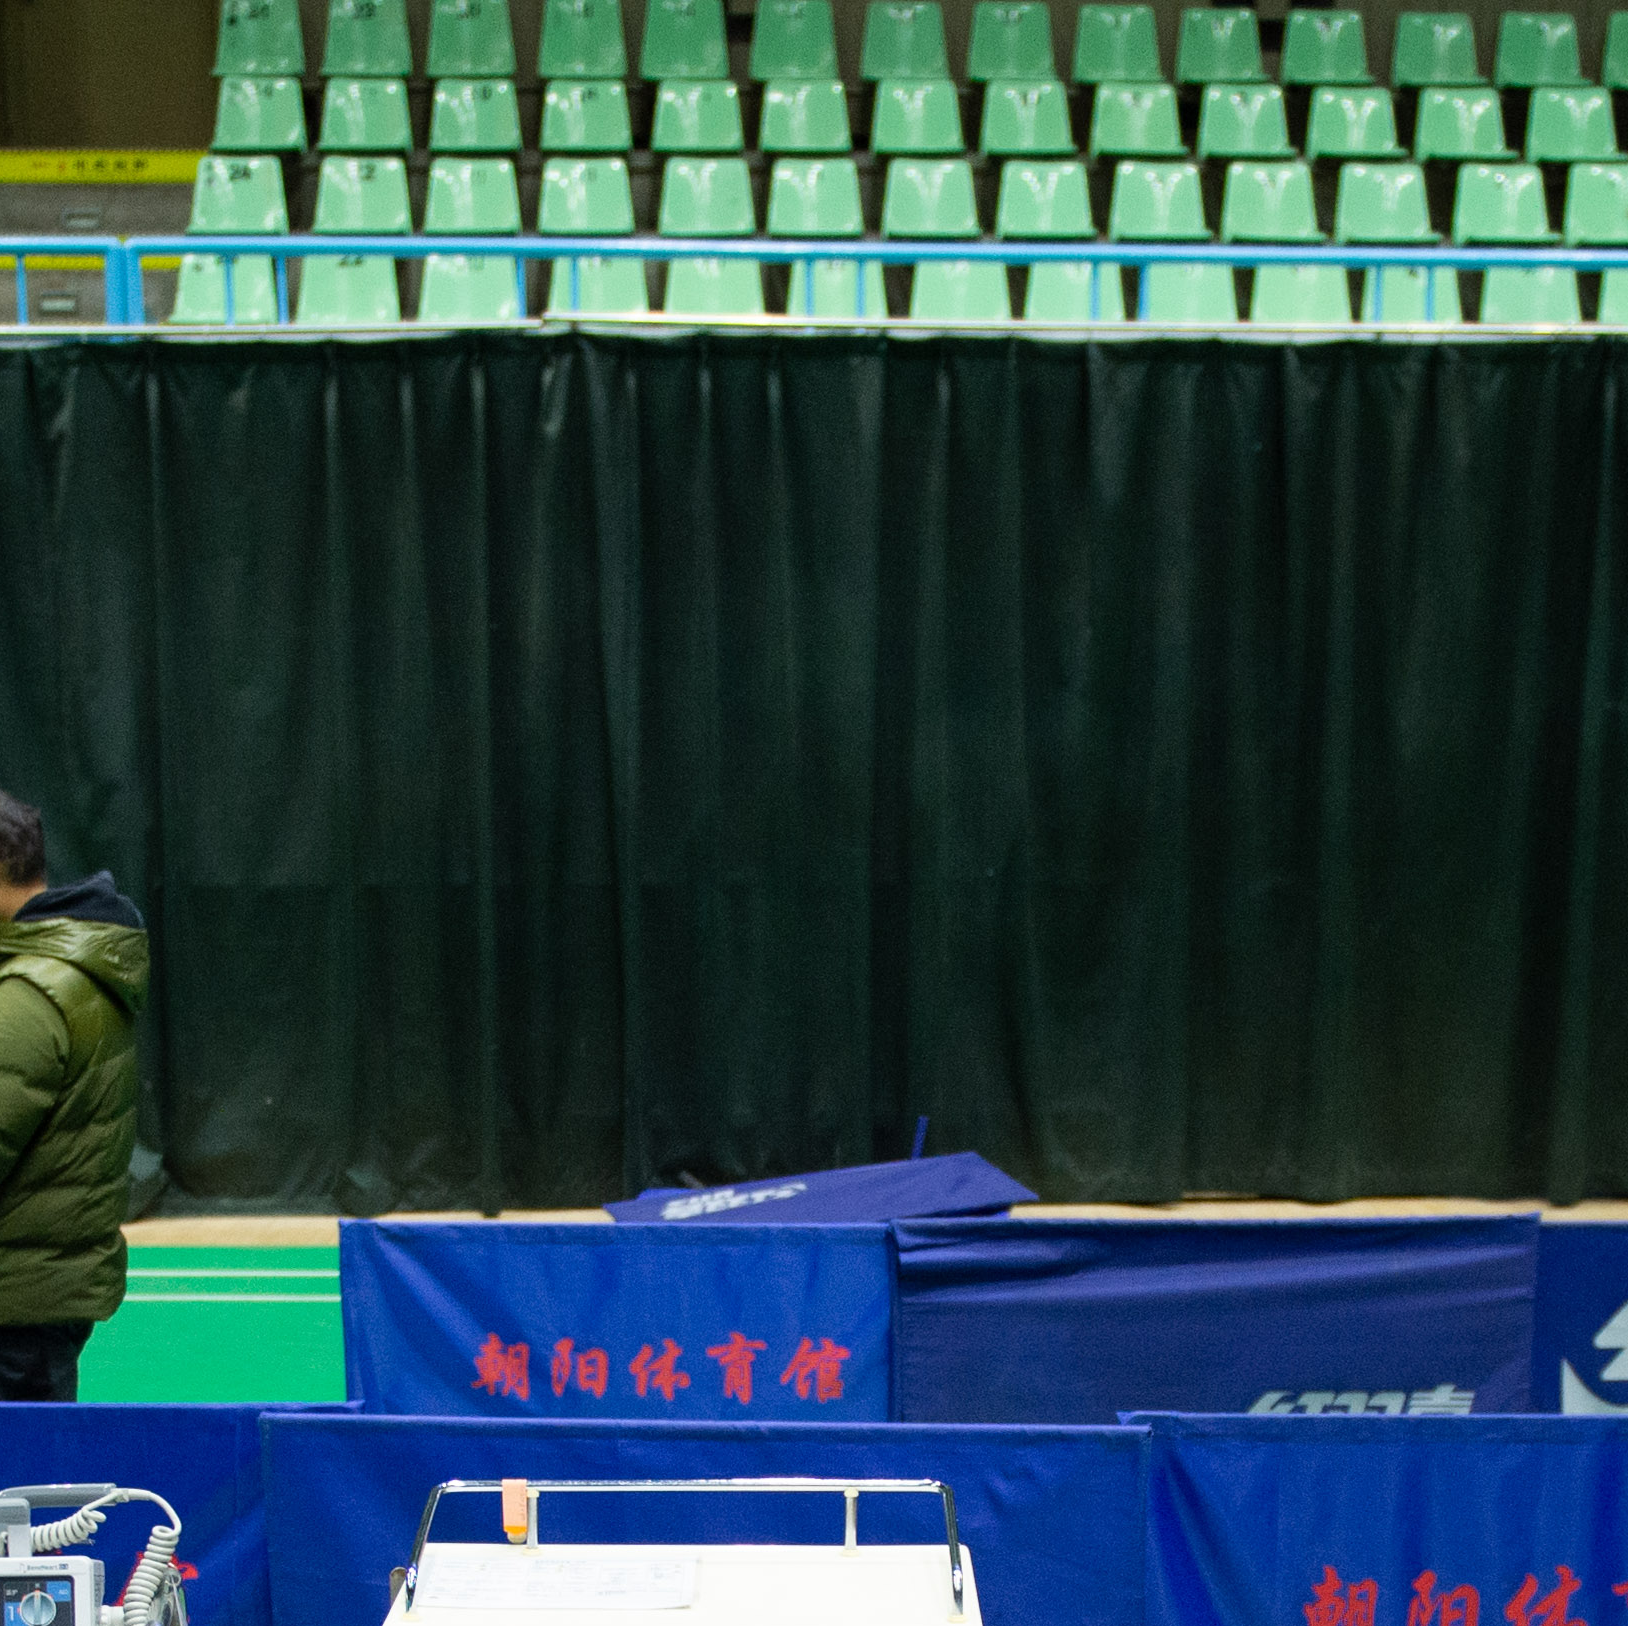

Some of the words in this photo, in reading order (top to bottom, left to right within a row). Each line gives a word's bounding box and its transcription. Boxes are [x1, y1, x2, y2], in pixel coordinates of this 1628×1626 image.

[471, 1332, 852, 1403] 朝阳体育馆
